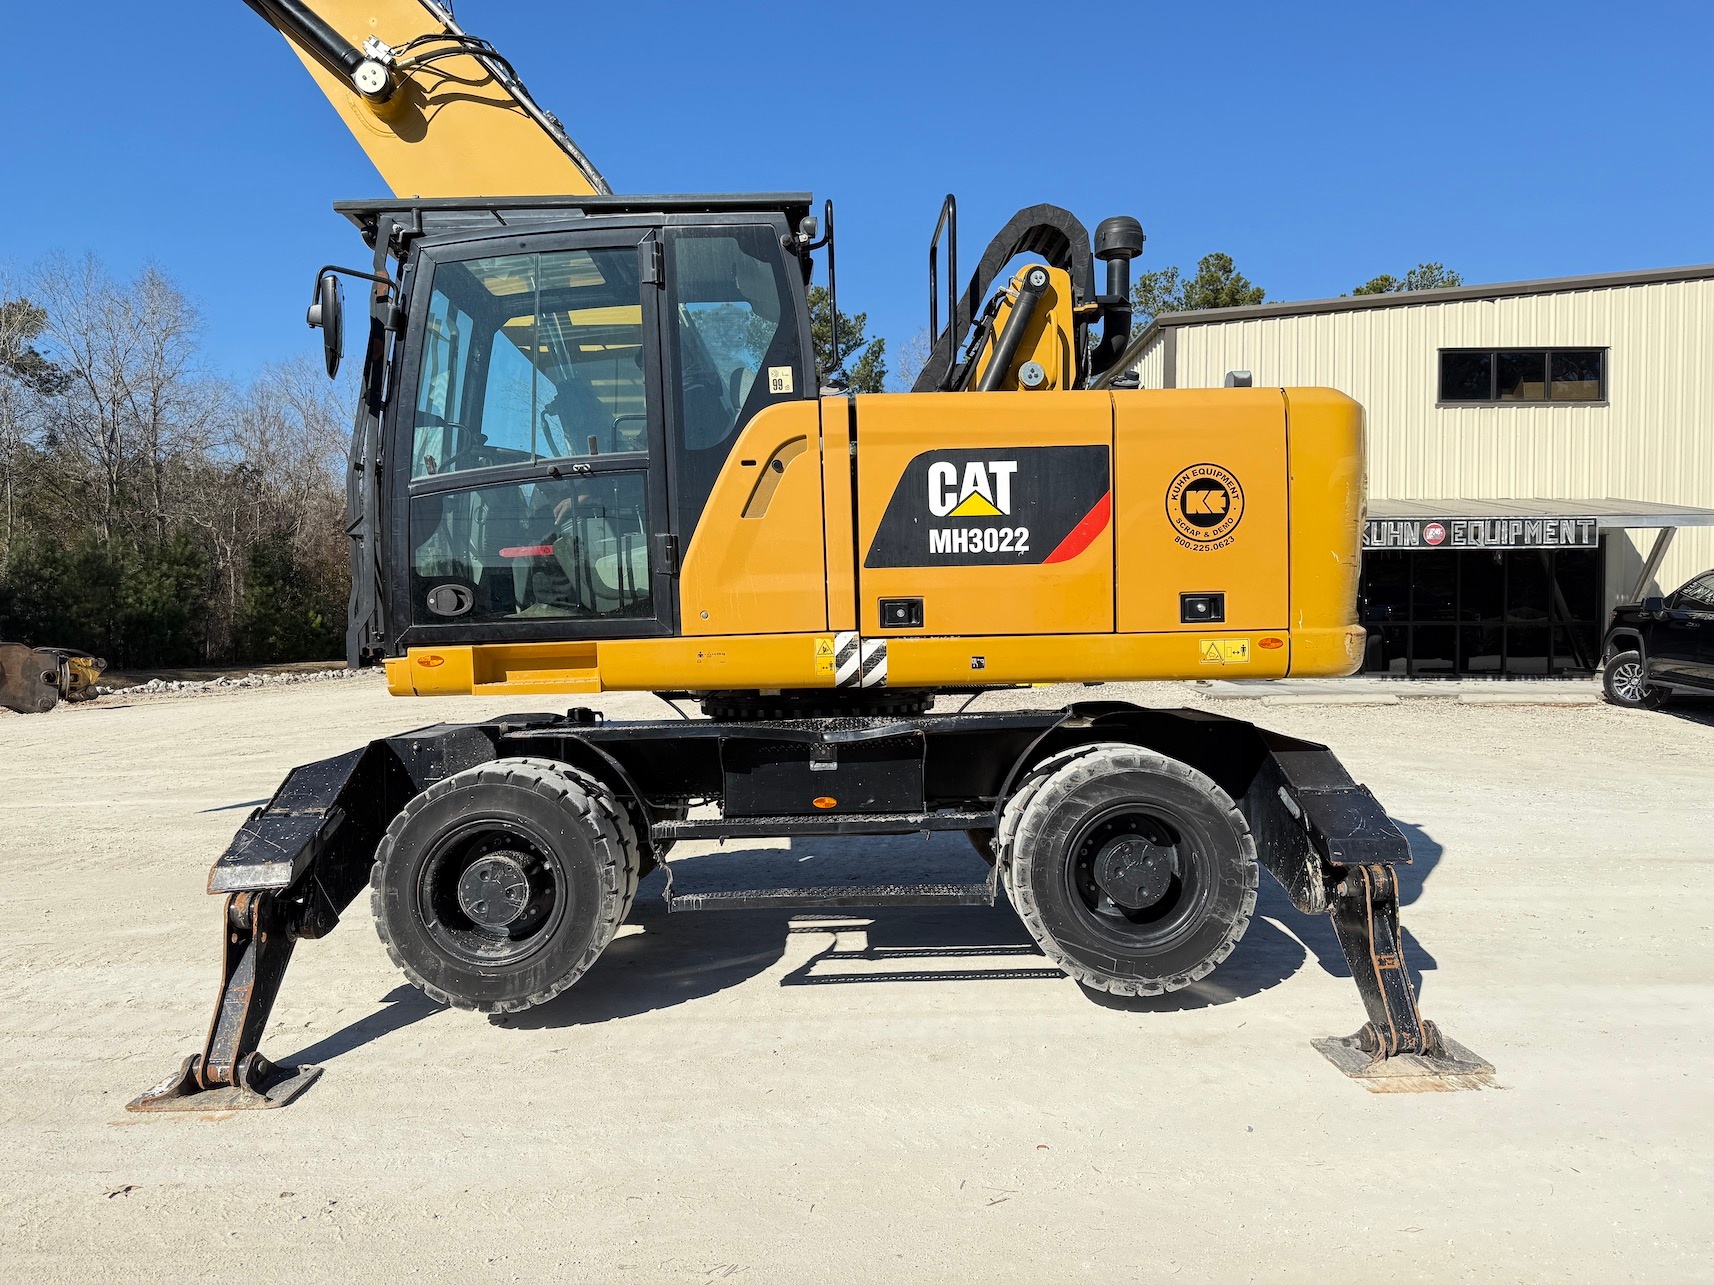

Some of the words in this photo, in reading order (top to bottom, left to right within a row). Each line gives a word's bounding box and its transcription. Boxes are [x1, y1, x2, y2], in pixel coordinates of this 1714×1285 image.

[772, 378, 783, 391] 99
[928, 460, 1018, 517] CAT
[1171, 473, 1190, 501] KUHN
[1191, 468, 1240, 500] EQUIPMENT
[929, 526, 1030, 554] MH3022
[1175, 517, 1201, 537] SCRAP
[1212, 517, 1234, 536] DEMO
[1450, 519, 1595, 547] EQUIPMENT
[1174, 535, 1236, 552] 800.225.0623
